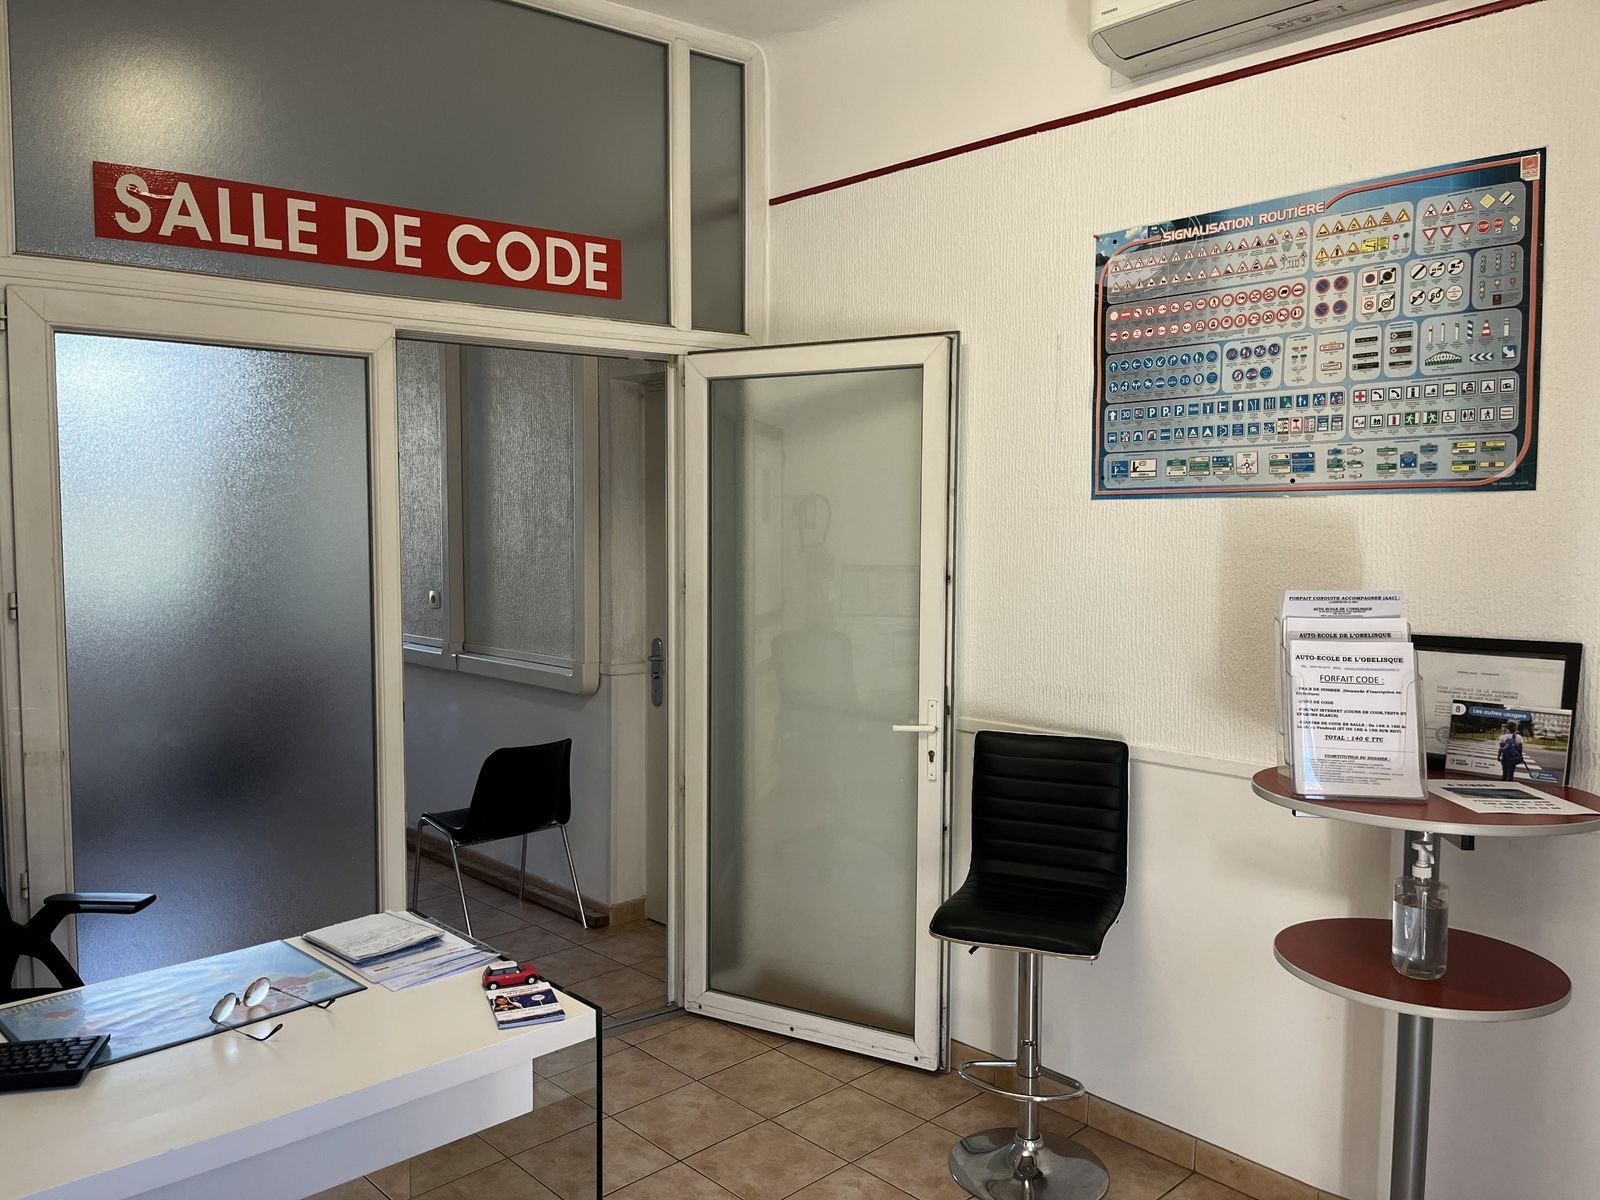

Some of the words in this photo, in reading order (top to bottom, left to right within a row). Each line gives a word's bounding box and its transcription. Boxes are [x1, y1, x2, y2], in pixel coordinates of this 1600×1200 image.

[1162, 215, 1254, 242] SIGNALISATION
[1258, 201, 1326, 224] ROUTIÈRE
[114, 173, 318, 255] SALLE
[345, 206, 422, 268] DE
[446, 223, 608, 291] CODE
[1122, 410, 1131, 419] 30
[1149, 408, 1156, 417] P
[1163, 407, 1170, 416] P
[1176, 405, 1183, 416] P
[1295, 654, 1340, 662] AUTO-ECOLE
[1354, 656, 1404, 664] L'OBELISQUE
[1319, 675, 1354, 684] FORFAIT
[1355, 676, 1379, 684] CODE
[1503, 712, 1527, 720] usagers
[1324, 734, 1345, 742] TOTAL
